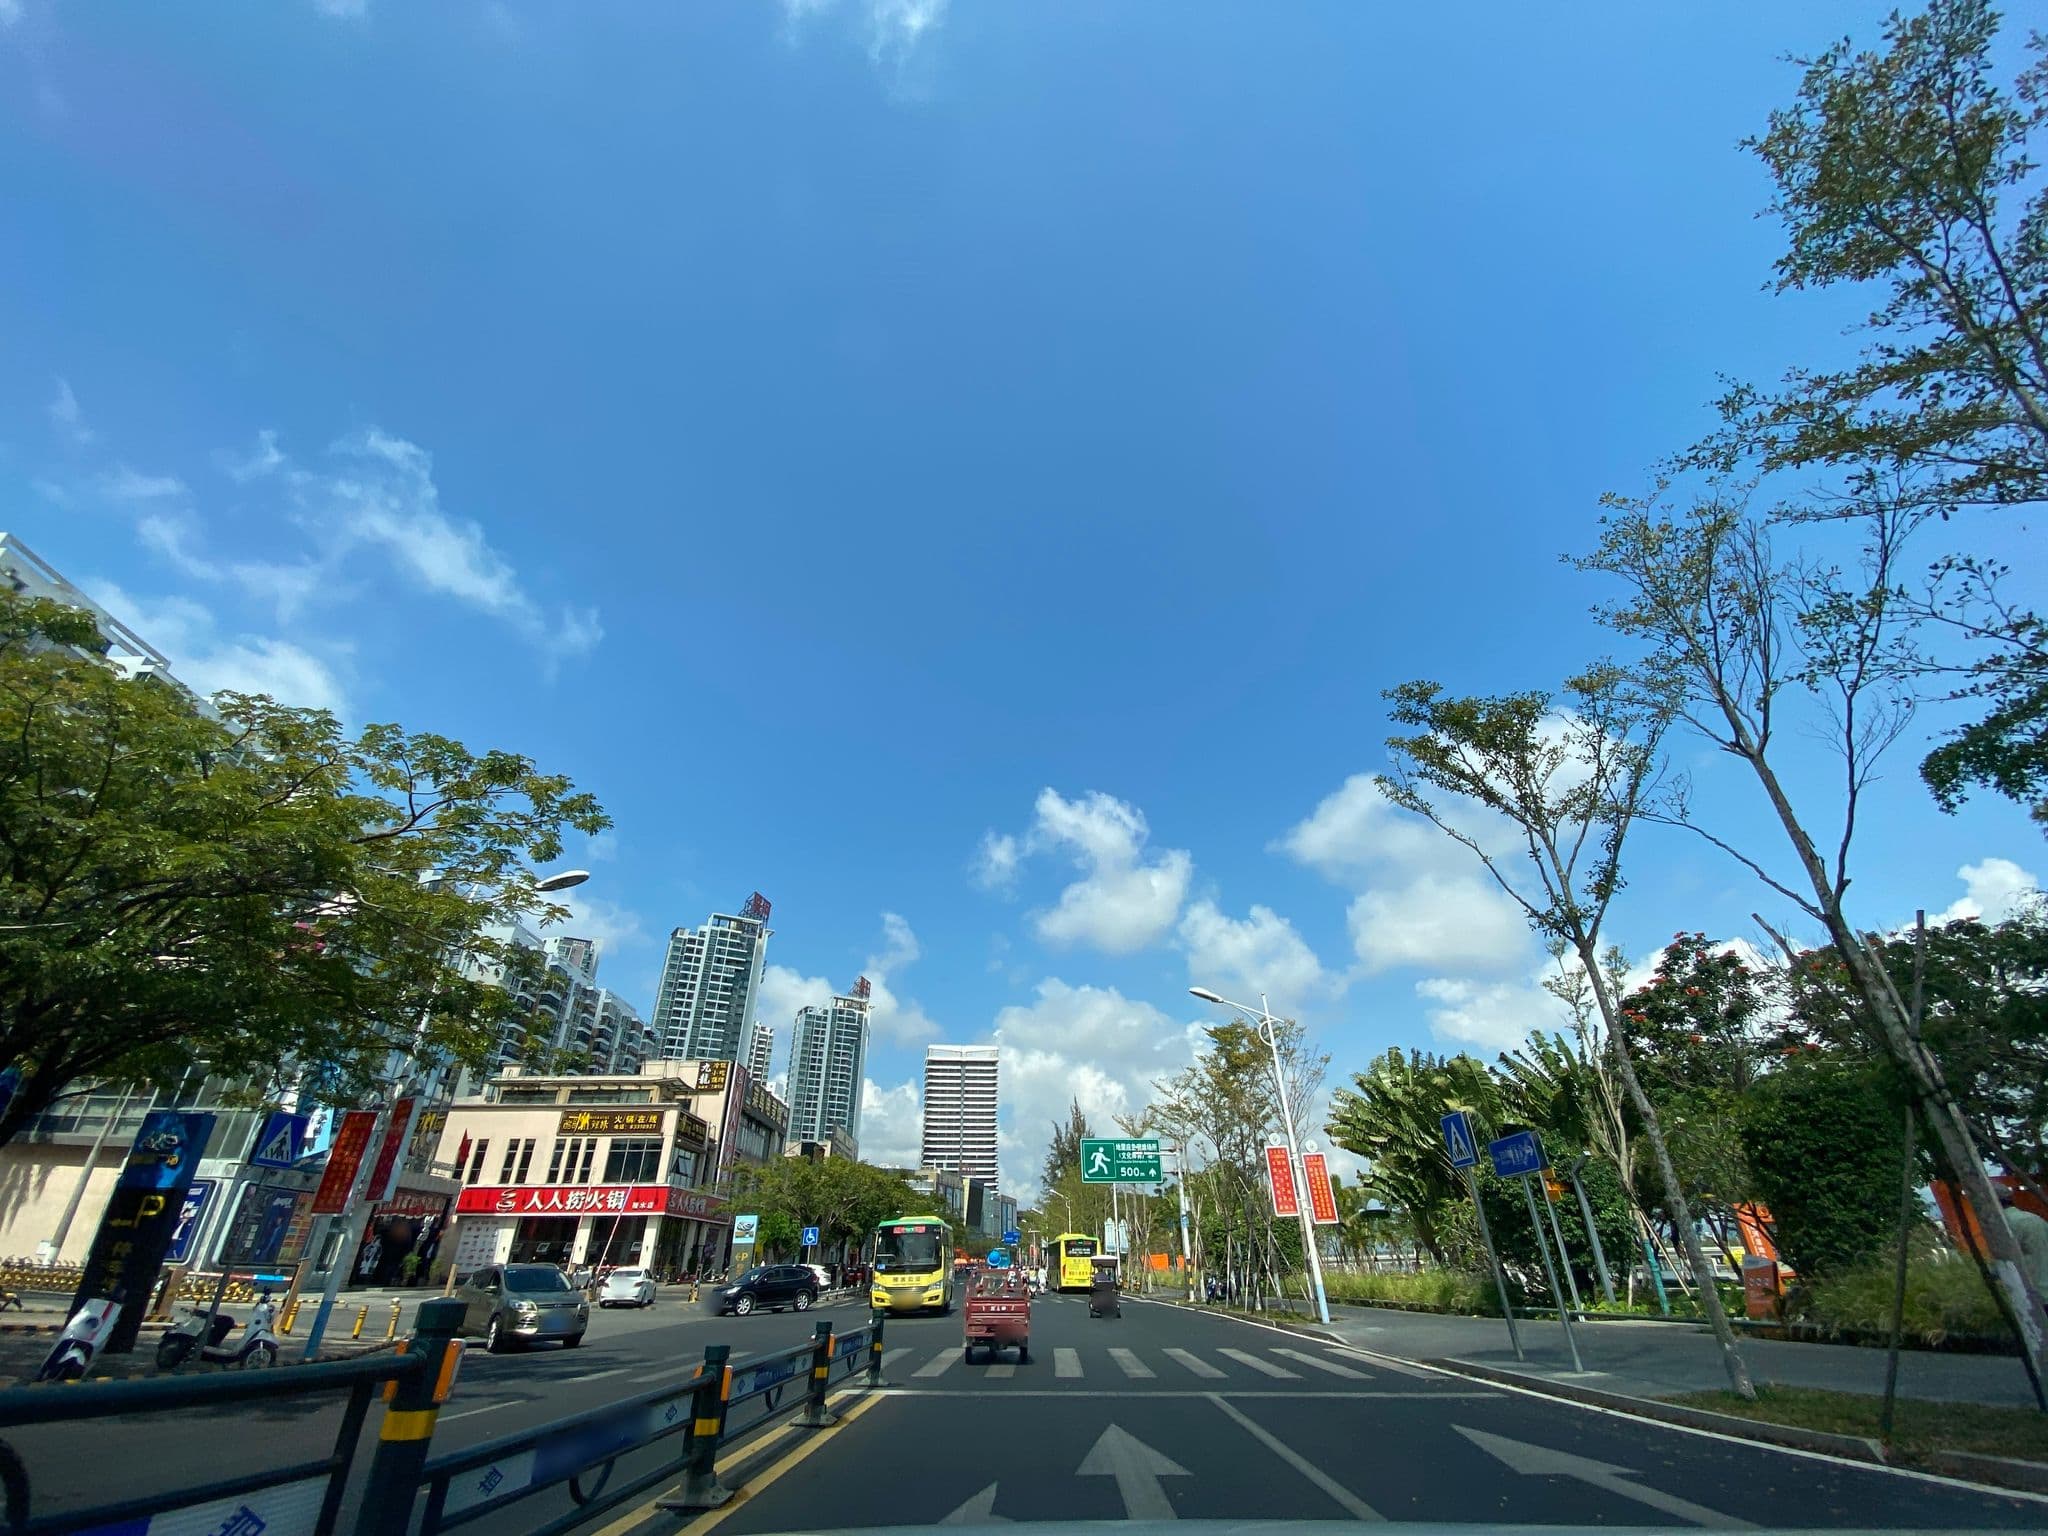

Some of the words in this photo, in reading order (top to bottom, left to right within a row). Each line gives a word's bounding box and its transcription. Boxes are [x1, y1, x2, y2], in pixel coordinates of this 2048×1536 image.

[134, 1195, 166, 1229] P
[523, 1190, 627, 1211] 人人捞火锅
